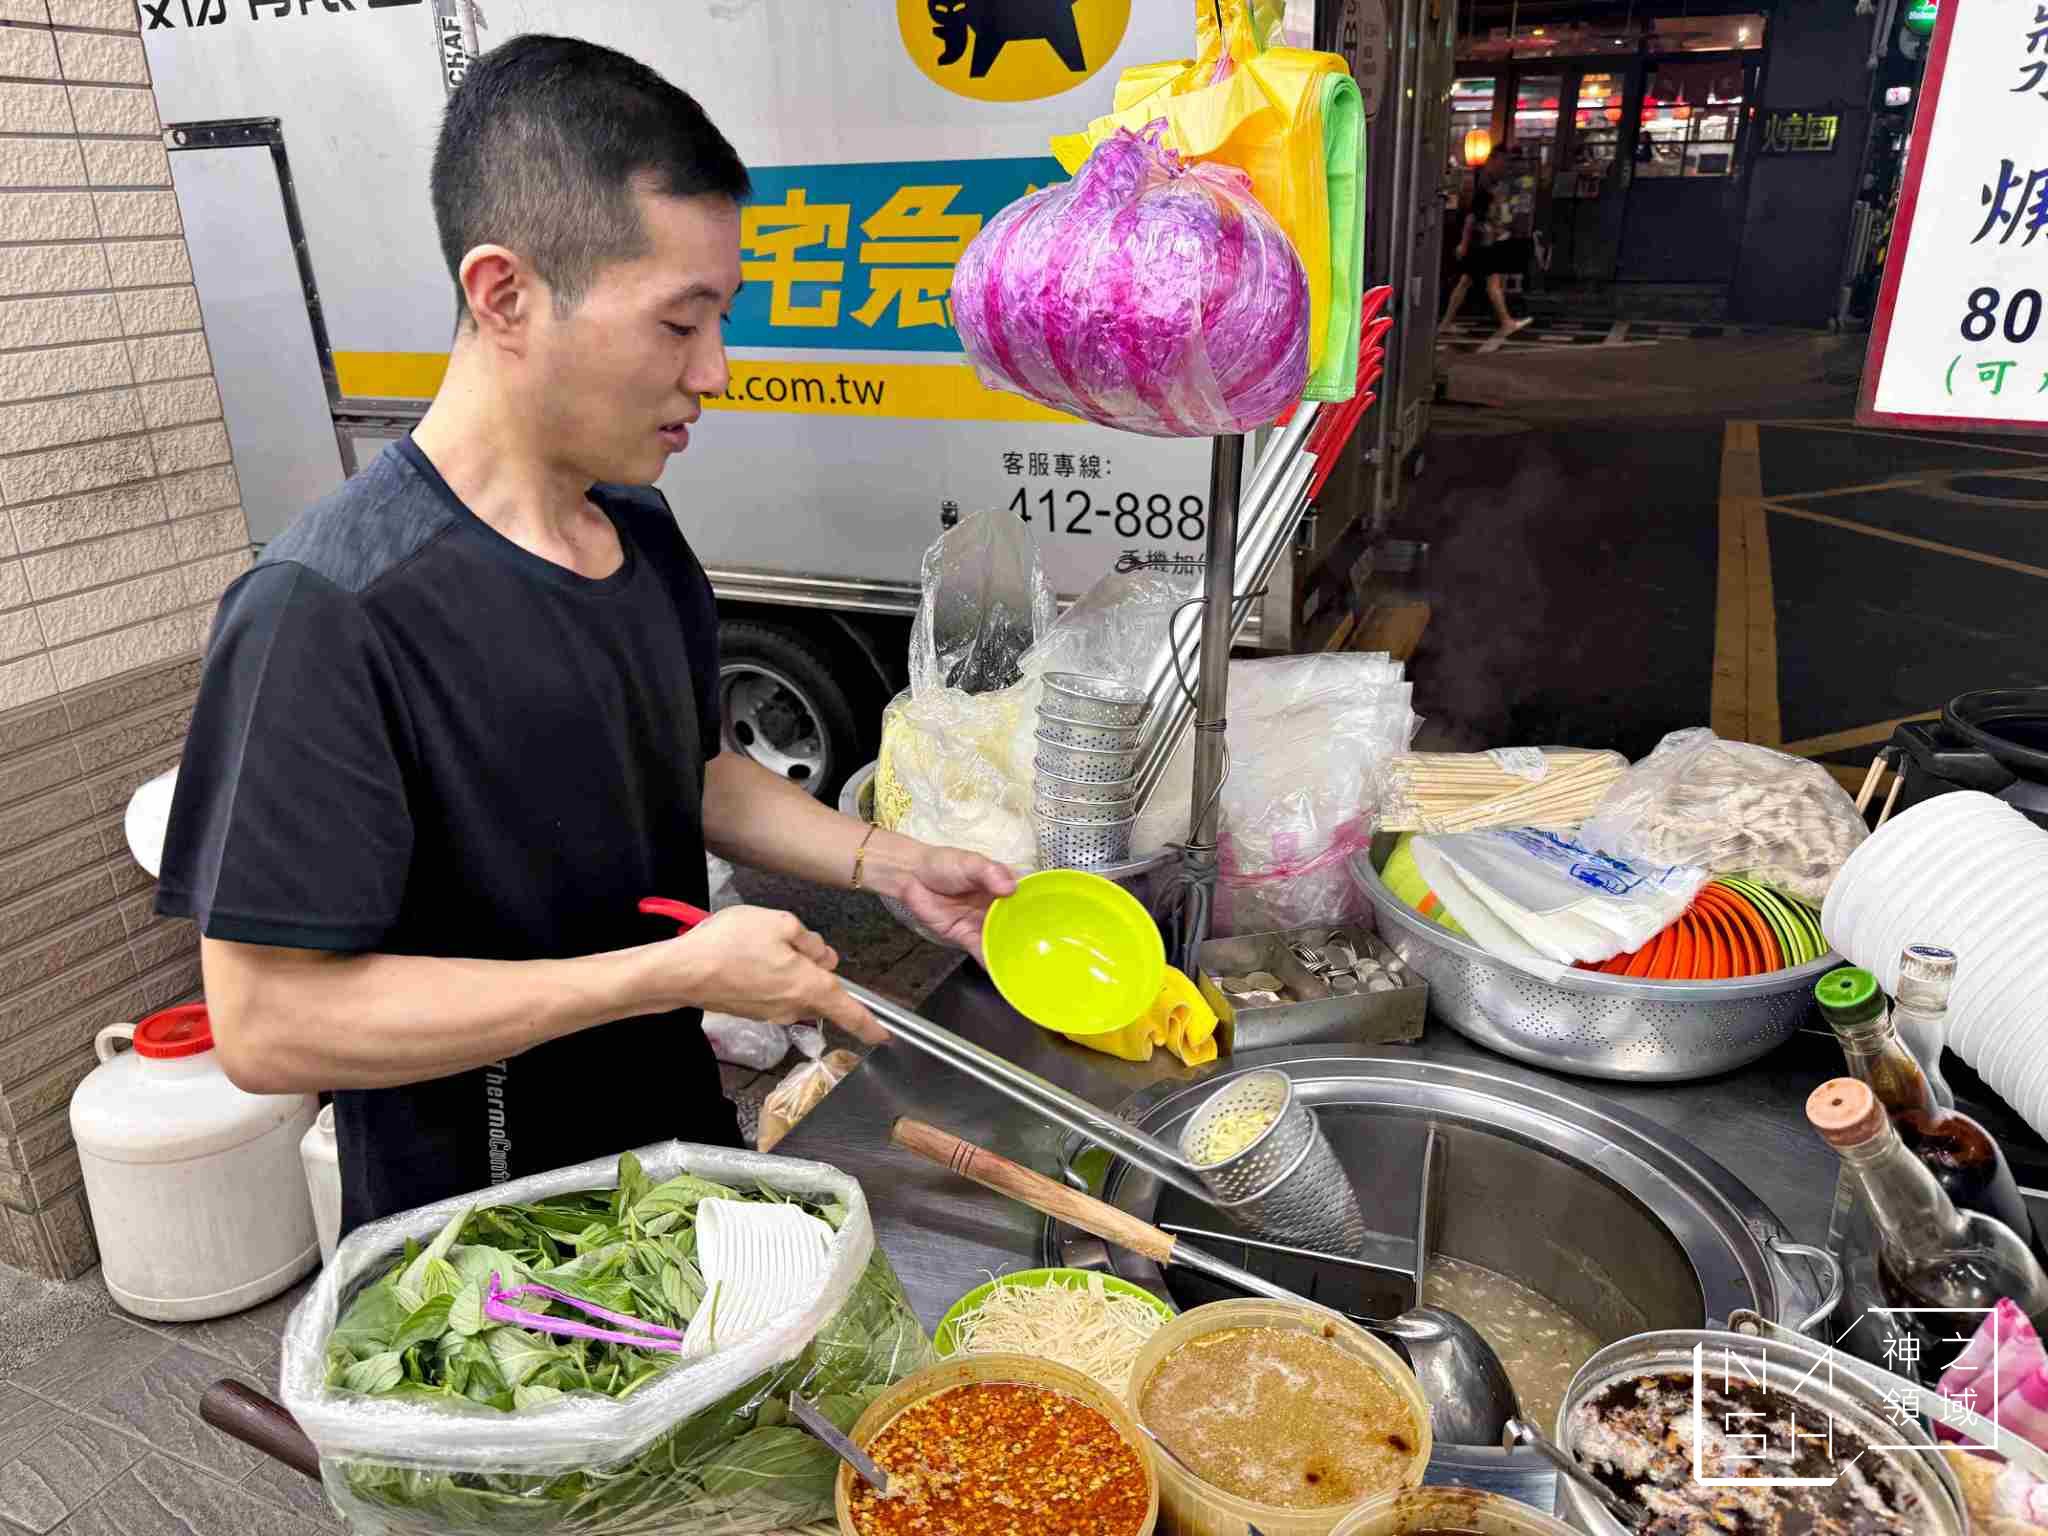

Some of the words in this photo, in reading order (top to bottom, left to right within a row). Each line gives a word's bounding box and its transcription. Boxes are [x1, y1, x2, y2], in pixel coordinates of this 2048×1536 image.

[739, 184, 1040, 328] 宅急
[1960, 286, 2042, 344] 80
[1946, 354, 2048, 396] (可
